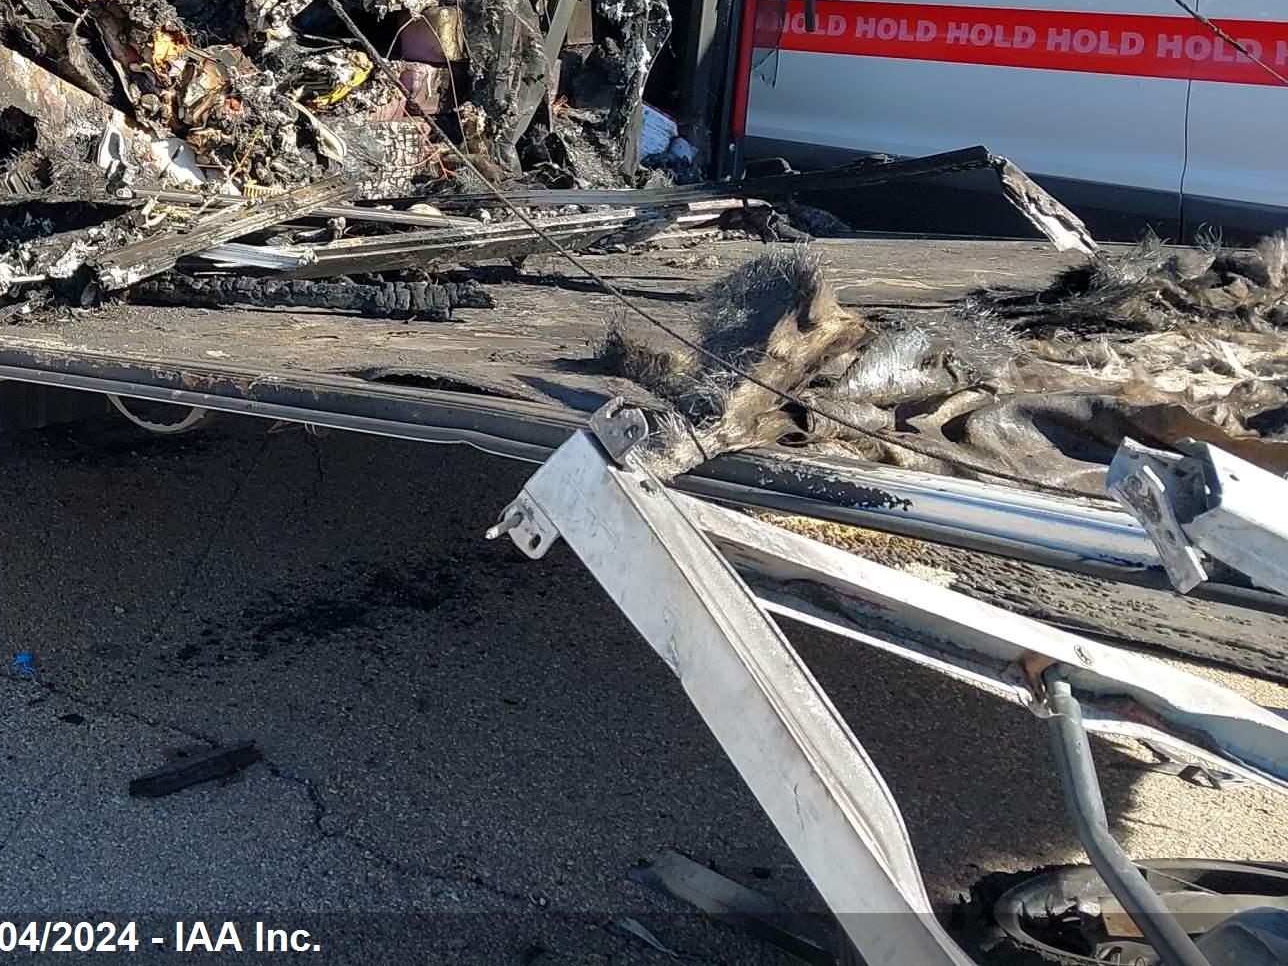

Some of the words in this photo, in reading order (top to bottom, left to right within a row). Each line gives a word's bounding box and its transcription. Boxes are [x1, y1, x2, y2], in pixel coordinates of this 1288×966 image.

[854, 16, 937, 42] HOLD
[946, 22, 1036, 49] HOLD
[1046, 27, 1145, 56] HOLD
[1156, 33, 1263, 64] HOLD
